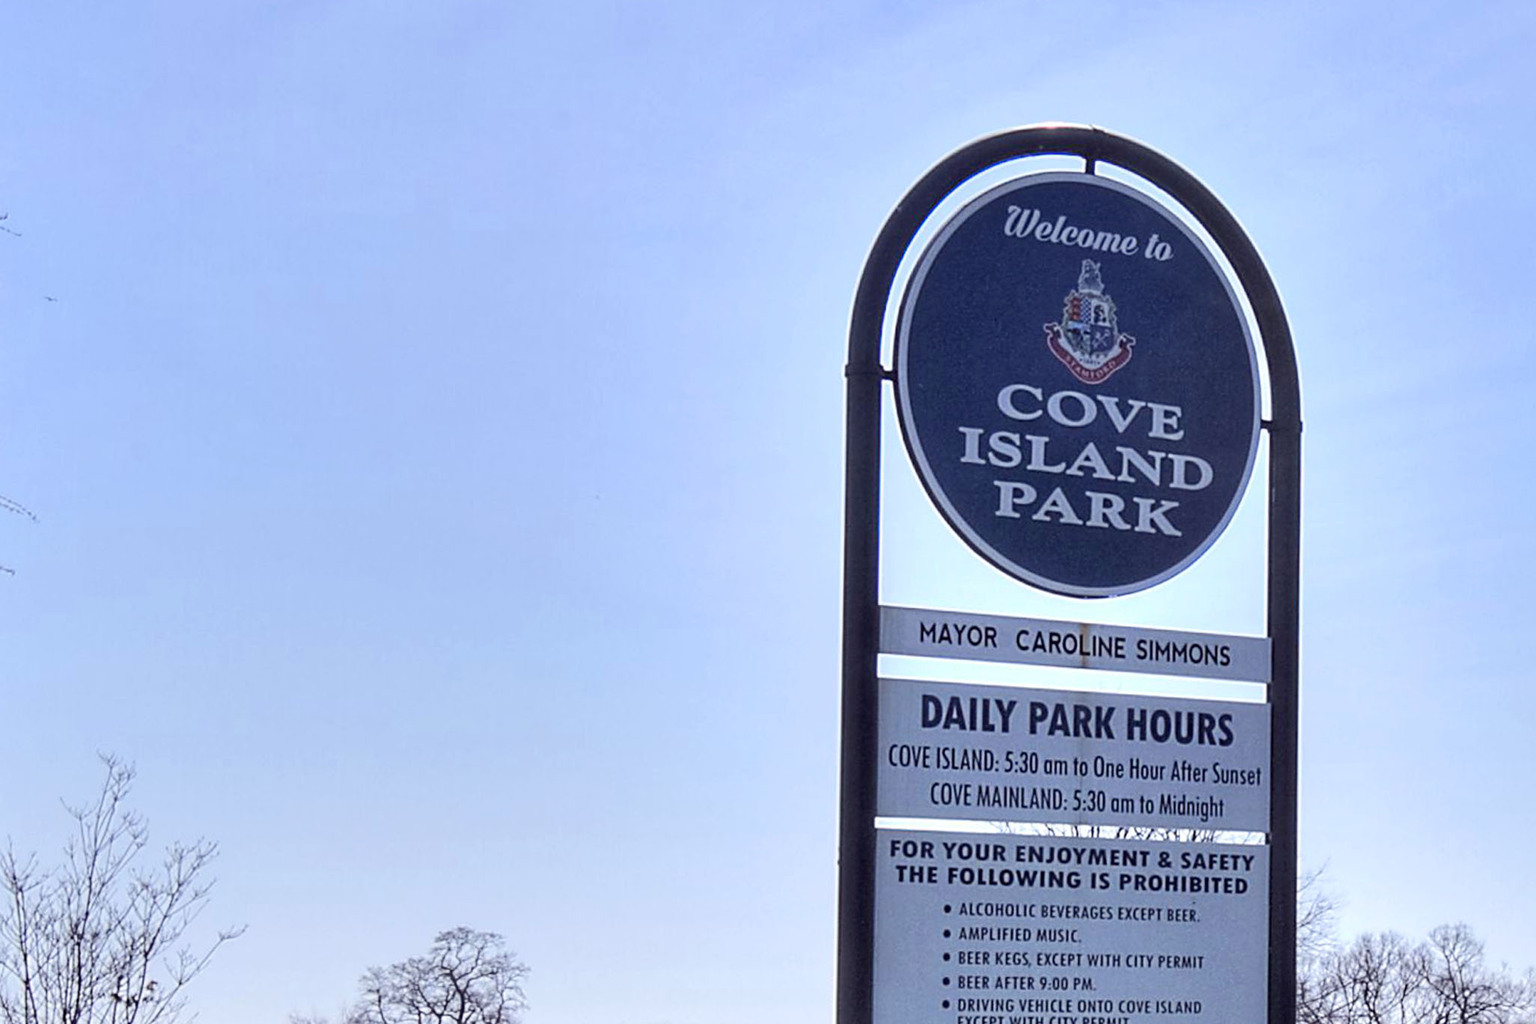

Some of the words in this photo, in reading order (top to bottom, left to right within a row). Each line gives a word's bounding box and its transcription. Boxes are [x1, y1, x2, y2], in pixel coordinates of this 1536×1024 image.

[1005, 206, 1137, 255] Welcome
[1145, 234, 1172, 260] to
[995, 385, 1184, 442] COVE
[959, 425, 1213, 493] ISLAND
[994, 478, 1184, 536] PARK
[920, 622, 997, 647] MAYOR
[1016, 630, 1125, 658] CAROLINE
[1137, 639, 1230, 666] SIMMONS
[922, 694, 1017, 733] DAILY
[1030, 702, 1115, 739] PARK
[1127, 708, 1233, 746] HOURS
[889, 744, 930, 768] COVE
[937, 747, 998, 772] ISLAND:
[1005, 751, 1038, 774] 5:30
[1044, 760, 1067, 775] am
[1073, 758, 1088, 776] to
[1094, 756, 1124, 778] One
[1130, 758, 1165, 780] Hour
[1171, 760, 1207, 782] After
[1213, 762, 1261, 785] Sunset
[931, 782, 971, 806] COVE
[977, 785, 1067, 810] MAINLAND:
[1073, 790, 1105, 812] 5:30
[1111, 798, 1134, 813] am
[1140, 796, 1154, 814] to
[1159, 794, 1223, 822] Midnight
[891, 840, 934, 858] FOR
[943, 842, 1005, 861] YOUR
[1016, 846, 1150, 867] ENJOYMENT
[1158, 852, 1171, 868] &
[1181, 852, 1254, 871] SAFETY
[896, 865, 937, 883] THE
[948, 868, 1081, 888] FOLLOWING
[1091, 873, 1109, 889] IS
[1120, 874, 1247, 894] PROHIBITED
[959, 903, 1035, 917] ALCOHOLIC
[1041, 905, 1113, 920] BEVERAGES
[1118, 907, 1162, 921] EXCEPT
[1167, 909, 1200, 922] BEER.
[959, 927, 1031, 941] AMPLIFIED
[1036, 929, 1081, 942] MUSIC.
[959, 951, 990, 964] BEER
[996, 952, 1031, 967] KEGS,
[1037, 953, 1082, 966] EXCEPT
[1087, 954, 1120, 967] WITH
[1126, 955, 1153, 967] CITY
[1158, 955, 1203, 968] PERMIT
[958, 976, 989, 989] BEER
[995, 977, 1034, 990] AFTER
[1040, 977, 1068, 990] 9:00
[1074, 978, 1096, 990] PM.
[958, 998, 1014, 1012] DRIVING
[1019, 999, 1071, 1013] VEHICLE
[1078, 1000, 1113, 1013] ONTO
[1119, 1000, 1150, 1014] COVE
[1156, 1001, 1201, 1014] ISLAND
